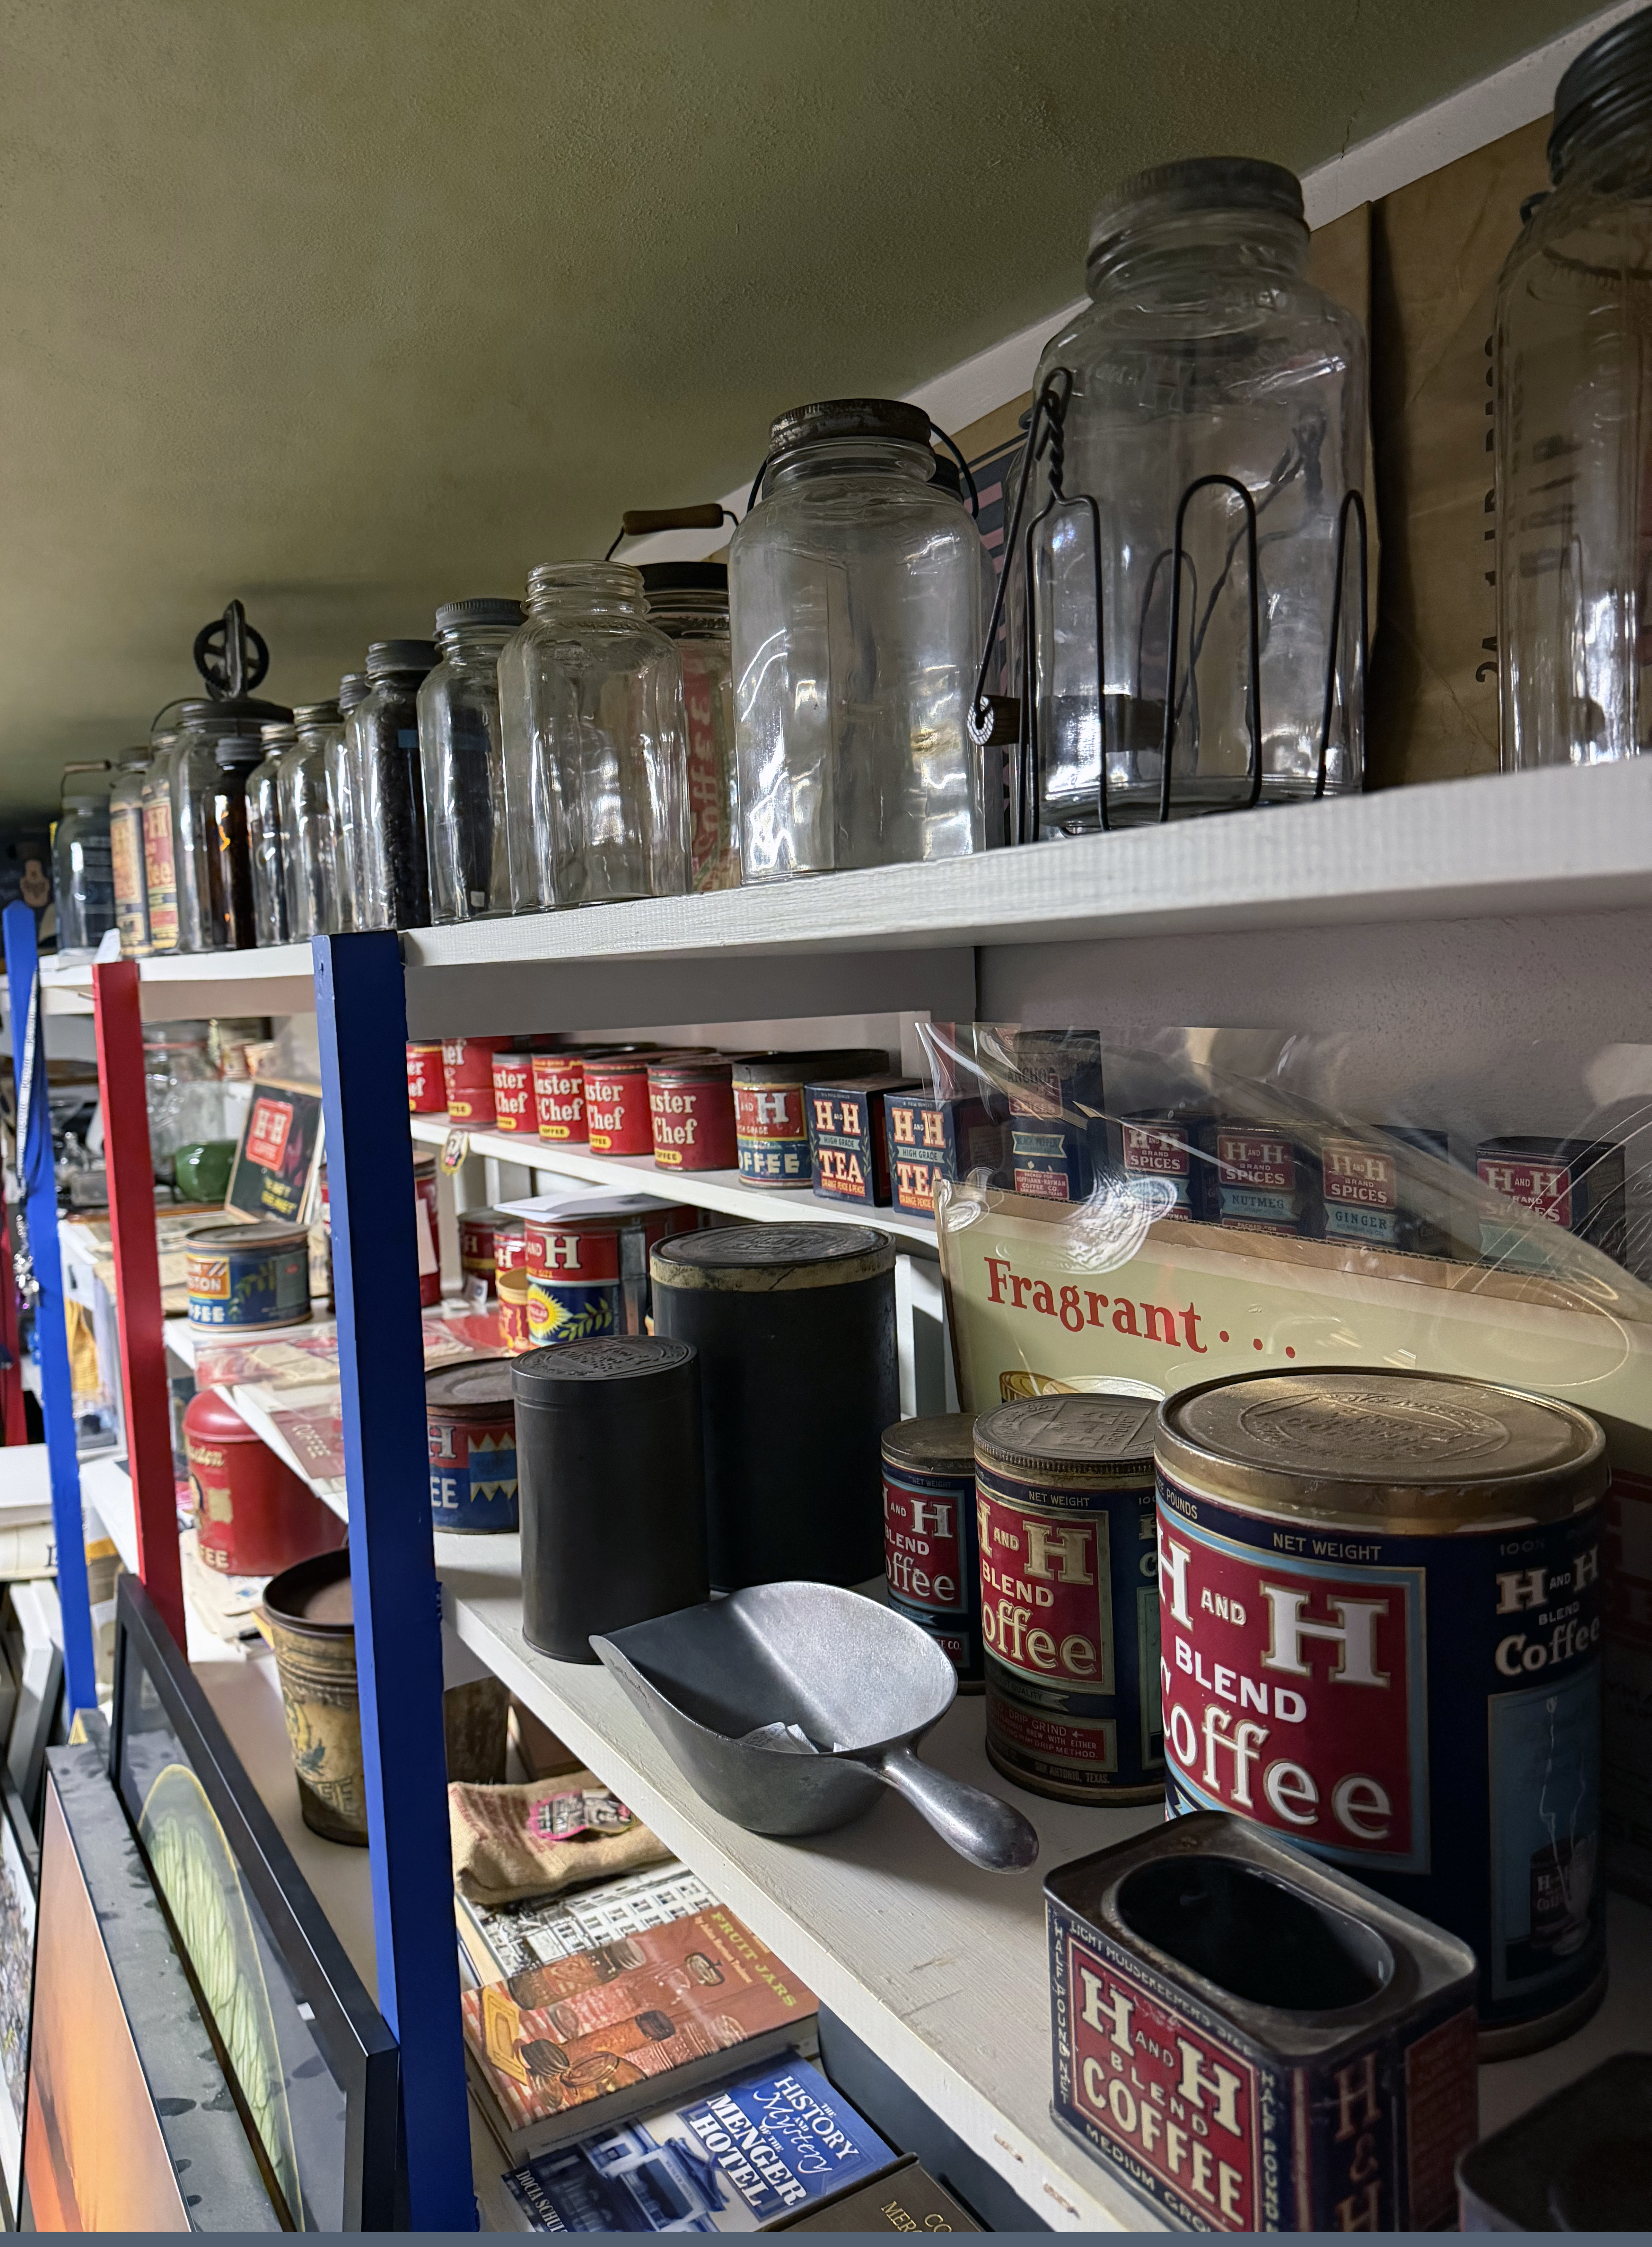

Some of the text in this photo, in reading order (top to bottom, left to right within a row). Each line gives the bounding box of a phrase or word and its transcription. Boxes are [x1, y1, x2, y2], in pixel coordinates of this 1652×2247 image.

[541, 1097, 584, 1122] Chef
[587, 1104, 625, 1131] Chef
[754, 1092, 789, 1125] H
[813, 1099, 836, 1133] H
[840, 1101, 862, 1136] H
[654, 1116, 698, 1145] Chef
[824, 1136, 854, 1148] HIGH GRADE
[892, 1107, 915, 1145] H
[921, 1110, 946, 1149] H
[1129, 1129, 1150, 1150] H
[1148, 1137, 1160, 1145] AND
[818, 1148, 865, 1184] TEA
[903, 1149, 938, 1161] HIGH GRADE
[1130, 1155, 1181, 1170] SPICES
[1225, 1141, 1250, 1162] H
[1260, 1143, 1284, 1164] H
[1331, 1154, 1388, 1182] H AND H
[1225, 1169, 1289, 1185] SPICES
[1345, 1178, 1374, 1188] BRAND
[1485, 1167, 1561, 1197] H AND H
[1232, 1194, 1284, 1210] NUTMEG
[1331, 1183, 1387, 1203] SPICES
[1512, 1195, 1543, 1205] RAND
[1335, 1211, 1387, 1229] GINGER
[544, 1235, 581, 1269] H
[912, 1477, 952, 1488] NET WEIGHT
[1029, 1490, 1090, 1508] NET WEIGHT
[1166, 1487, 1198, 1520] POUNDS
[890, 1498, 953, 1539] AND H
[884, 1522, 930, 1556] BLEND
[993, 1526, 1020, 1551] AND
[1022, 1520, 1094, 1586] H
[1273, 1532, 1382, 1561] NET WEIGHT
[885, 1552, 955, 1601] offee
[982, 1557, 1054, 1608] BLEND
[1495, 1542, 1599, 1615] H AND H
[1538, 1600, 1581, 1626] BLEND
[947, 1641, 962, 1650] CO.
[981, 1598, 1096, 1675] offee
[1199, 1586, 1247, 1627] AND
[1260, 1580, 1392, 1689] H
[1494, 1615, 1600, 1677] Coffee
[1011, 1684, 1043, 1701] QUALITY
[1174, 1633, 1308, 1724] BLEND
[1026, 1728, 1096, 1750] BREW WITH EITHER
[1031, 1720, 1067, 1737] GRIND
[1035, 1740, 1054, 1751] DRIP
[1086, 1773, 1111, 1784] TEXAS.
[711, 1912, 758, 1961] FRUIT
[754, 1963, 796, 2007] JARS
[1053, 1924, 1064, 1978] HALF
[1080, 1965, 1242, 2137] H AND H
[1111, 2050, 1209, 2136] BLEND
[1334, 2049, 1383, 2143] H
[774, 2075, 860, 2161] HISTORY
[793, 2116, 809, 2132] AND
[820, 2102, 837, 2118] THE
[753, 2090, 833, 2174] Mystery
[758, 2125, 785, 2153] OF THE
[1083, 2056, 1245, 2227] COFFEE
[689, 2112, 770, 2207] HOTEL
[706, 2092, 807, 2207] MENGER
[1086, 2123, 1155, 2192] MEDIUM
[515, 2170, 568, 2232] DOCIA SCHUL
[880, 2200, 923, 2232] MER
